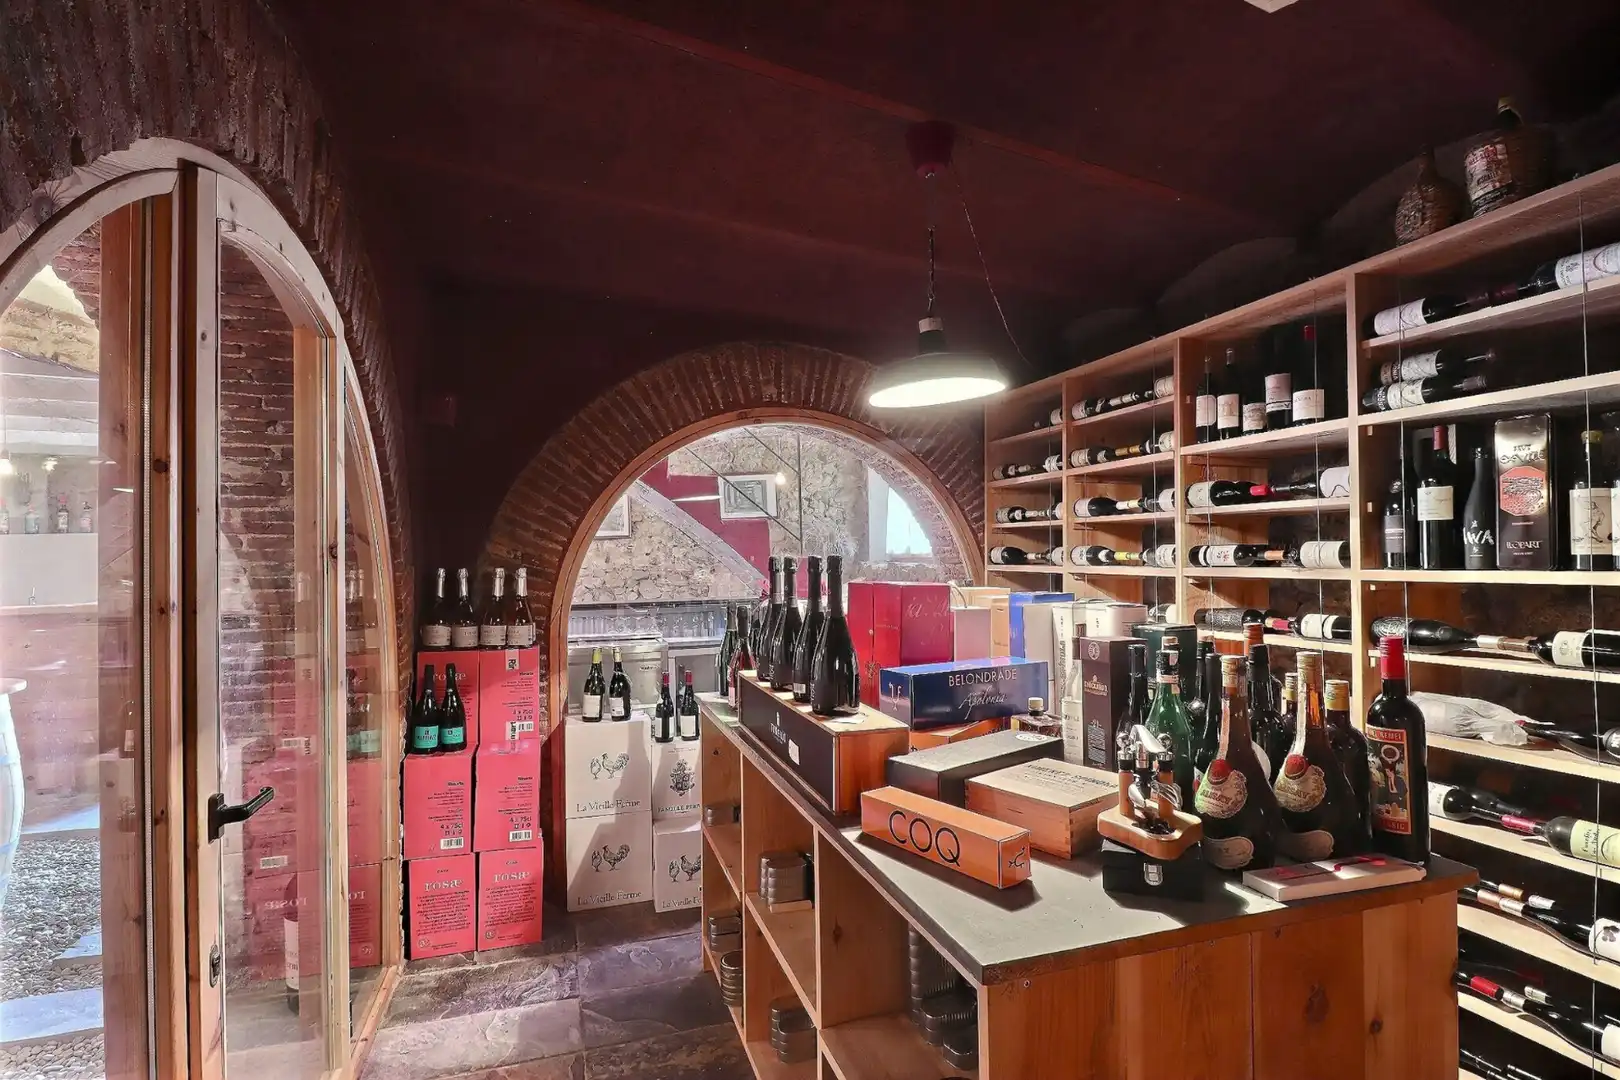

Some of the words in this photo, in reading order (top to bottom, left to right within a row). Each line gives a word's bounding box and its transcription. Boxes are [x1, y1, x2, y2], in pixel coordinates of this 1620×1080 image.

[1463, 527, 1494, 545] IWA
[949, 668, 1017, 687] BELONDRADE
[576, 803, 587, 812] La
[588, 801, 614, 810] Vieille
[616, 799, 640, 808] Ferme
[685, 803, 700, 811] PERR
[888, 809, 961, 867] COQ
[577, 896, 588, 905] La
[589, 893, 615, 903] Vieille
[617, 890, 642, 900] Ferme
[662, 901, 671, 909] La
[672, 898, 693, 907] Vieille
